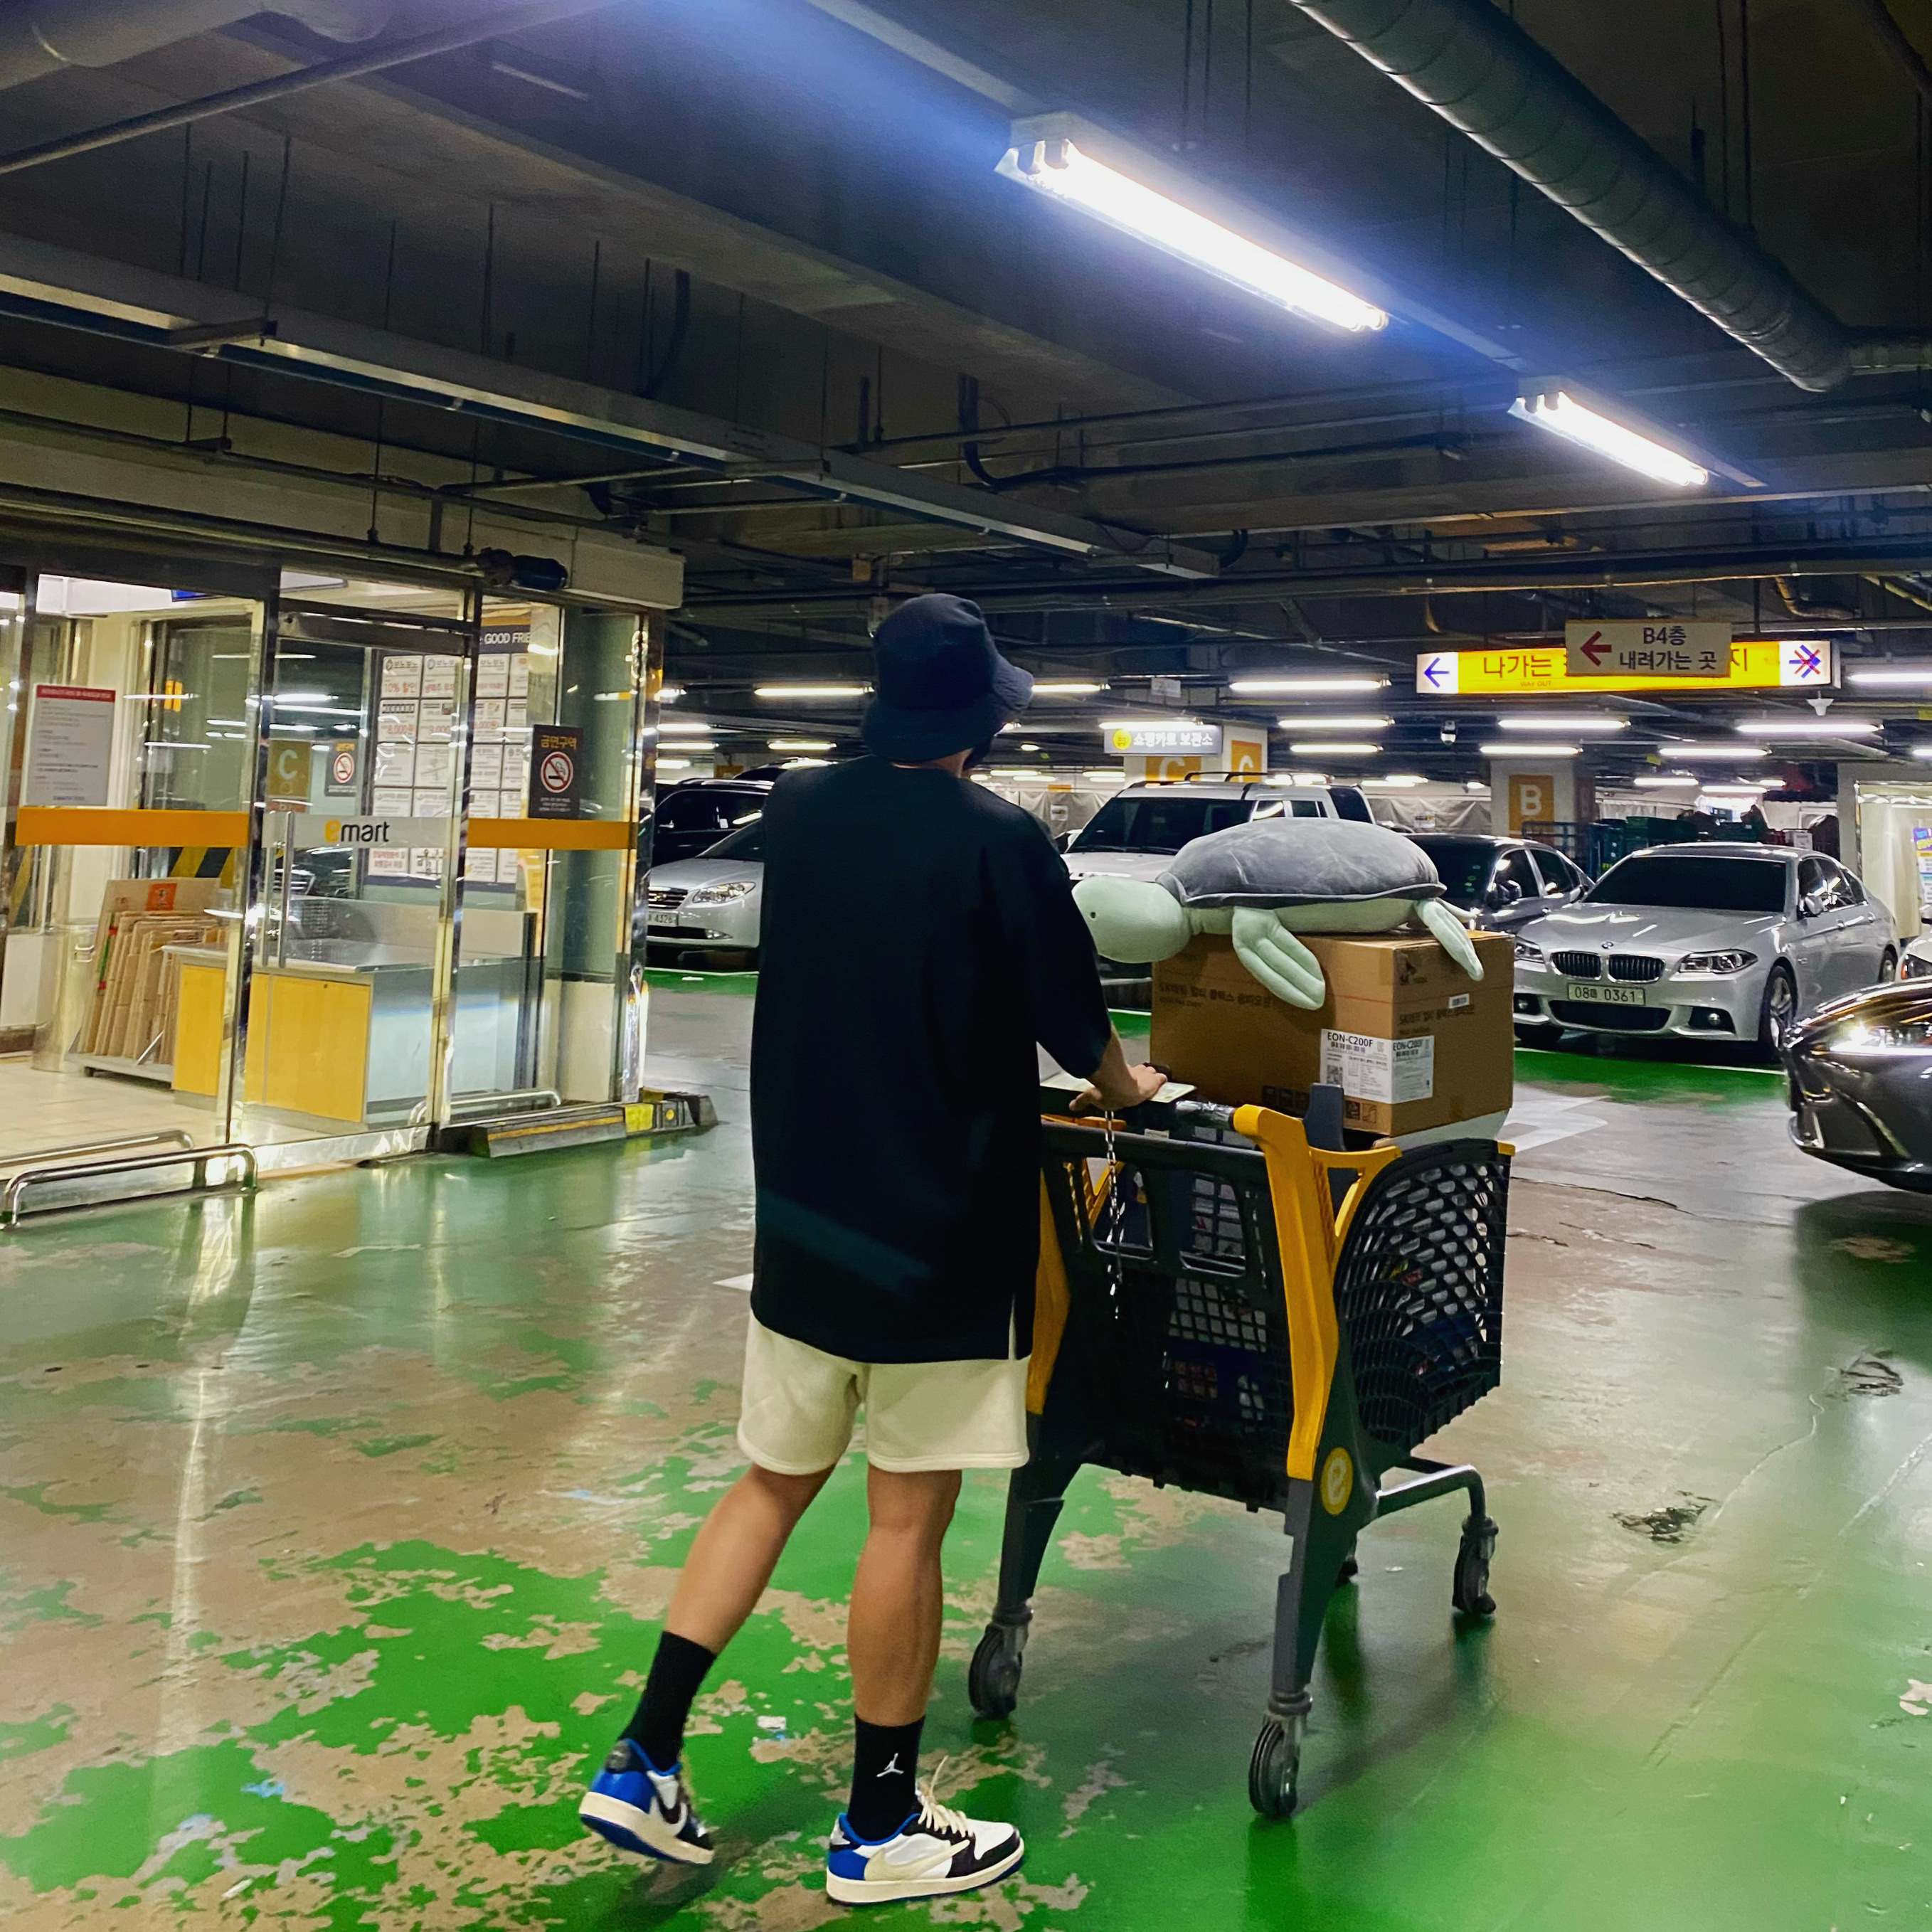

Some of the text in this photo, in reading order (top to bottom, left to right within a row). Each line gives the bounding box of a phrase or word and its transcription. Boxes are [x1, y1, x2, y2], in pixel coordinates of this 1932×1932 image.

[484, 632, 511, 644] GOOD
[1643, 625, 1687, 645] B4층
[1484, 654, 1551, 678] 나가는
[1620, 650, 1717, 670] 내려가는 곳
[278, 749, 299, 780] C
[1519, 784, 1542, 816] B
[324, 819, 391, 843] emart
[1604, 989, 1637, 1002] 0361
[1327, 1031, 1374, 1048] EON-C200F
